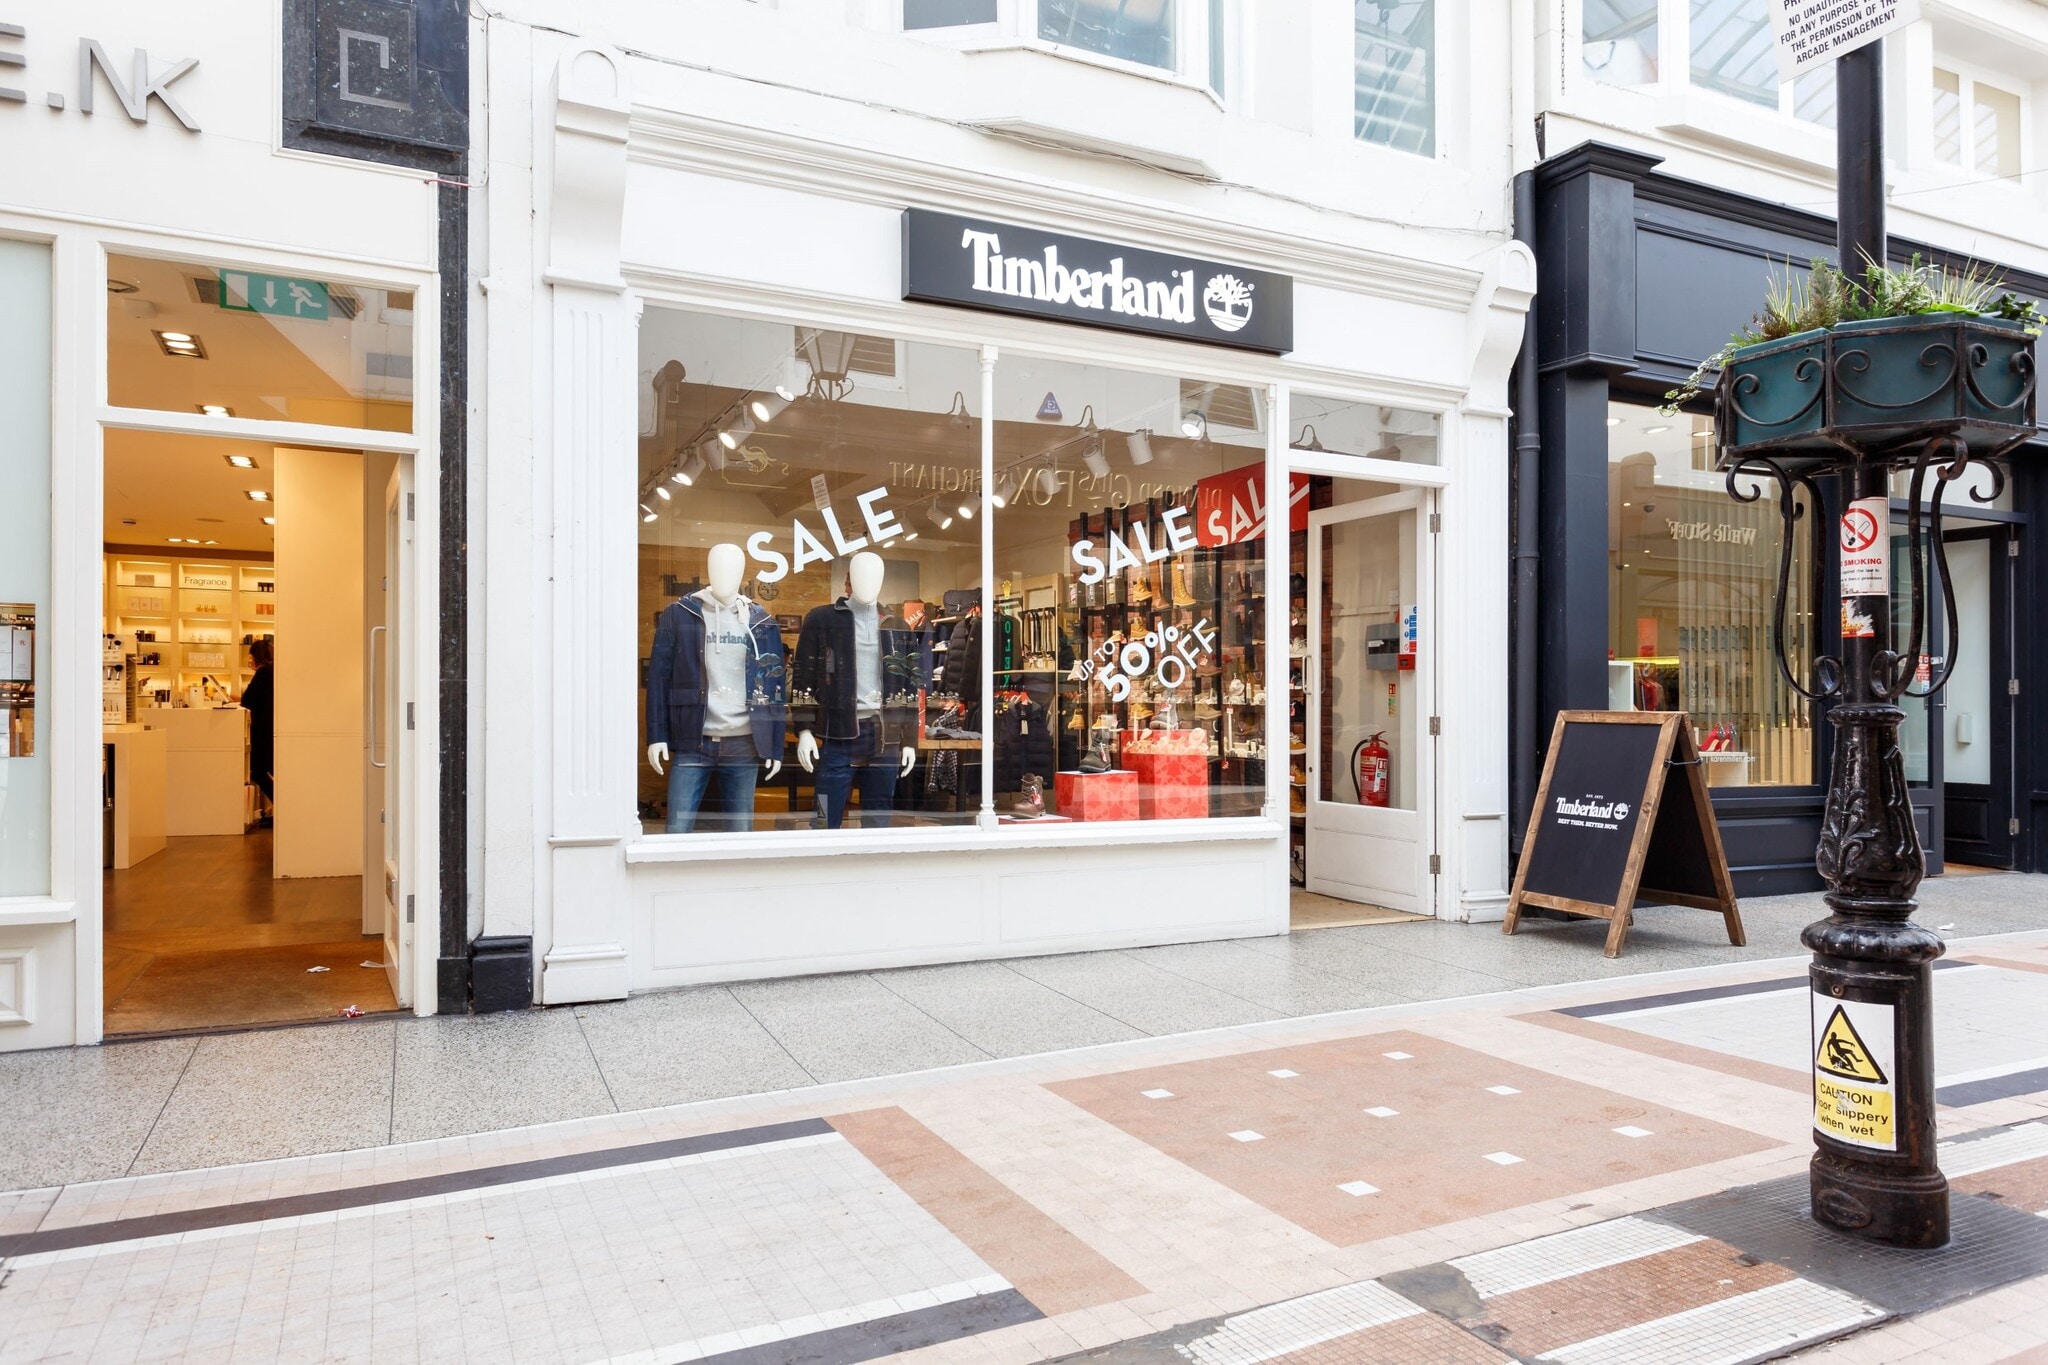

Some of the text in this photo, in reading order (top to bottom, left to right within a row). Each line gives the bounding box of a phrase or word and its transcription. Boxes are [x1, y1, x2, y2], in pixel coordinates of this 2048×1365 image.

[1780, 30, 1797, 45] FOR
[1800, 19, 1817, 35] ANY
[1820, 0, 1859, 24] PURPOSE
[1789, 14, 1801, 27] NO
[1791, 38, 1807, 53] THE
[1809, 10, 1862, 44] PERMISSION
[1866, 3, 1877, 16] OF
[1796, 8, 1897, 64] ARCADE MANAGEMENT
[961, 228, 1196, 324] Timberland
[746, 486, 904, 583] SALE
[1208, 477, 1295, 548] SAL
[1071, 505, 1199, 584] SALE
[1843, 558, 1882, 567] SMOKING
[184, 576, 227, 587] Fragrance
[1075, 640, 1116, 682] UP TO
[1099, 621, 1179, 702] 50%
[1157, 617, 1216, 689] OFF
[1556, 797, 1614, 819] Timberland
[1820, 1083, 1873, 1106] CAUTION
[1835, 1104, 1888, 1125] slippery
[1821, 1114, 1875, 1137] when wet
